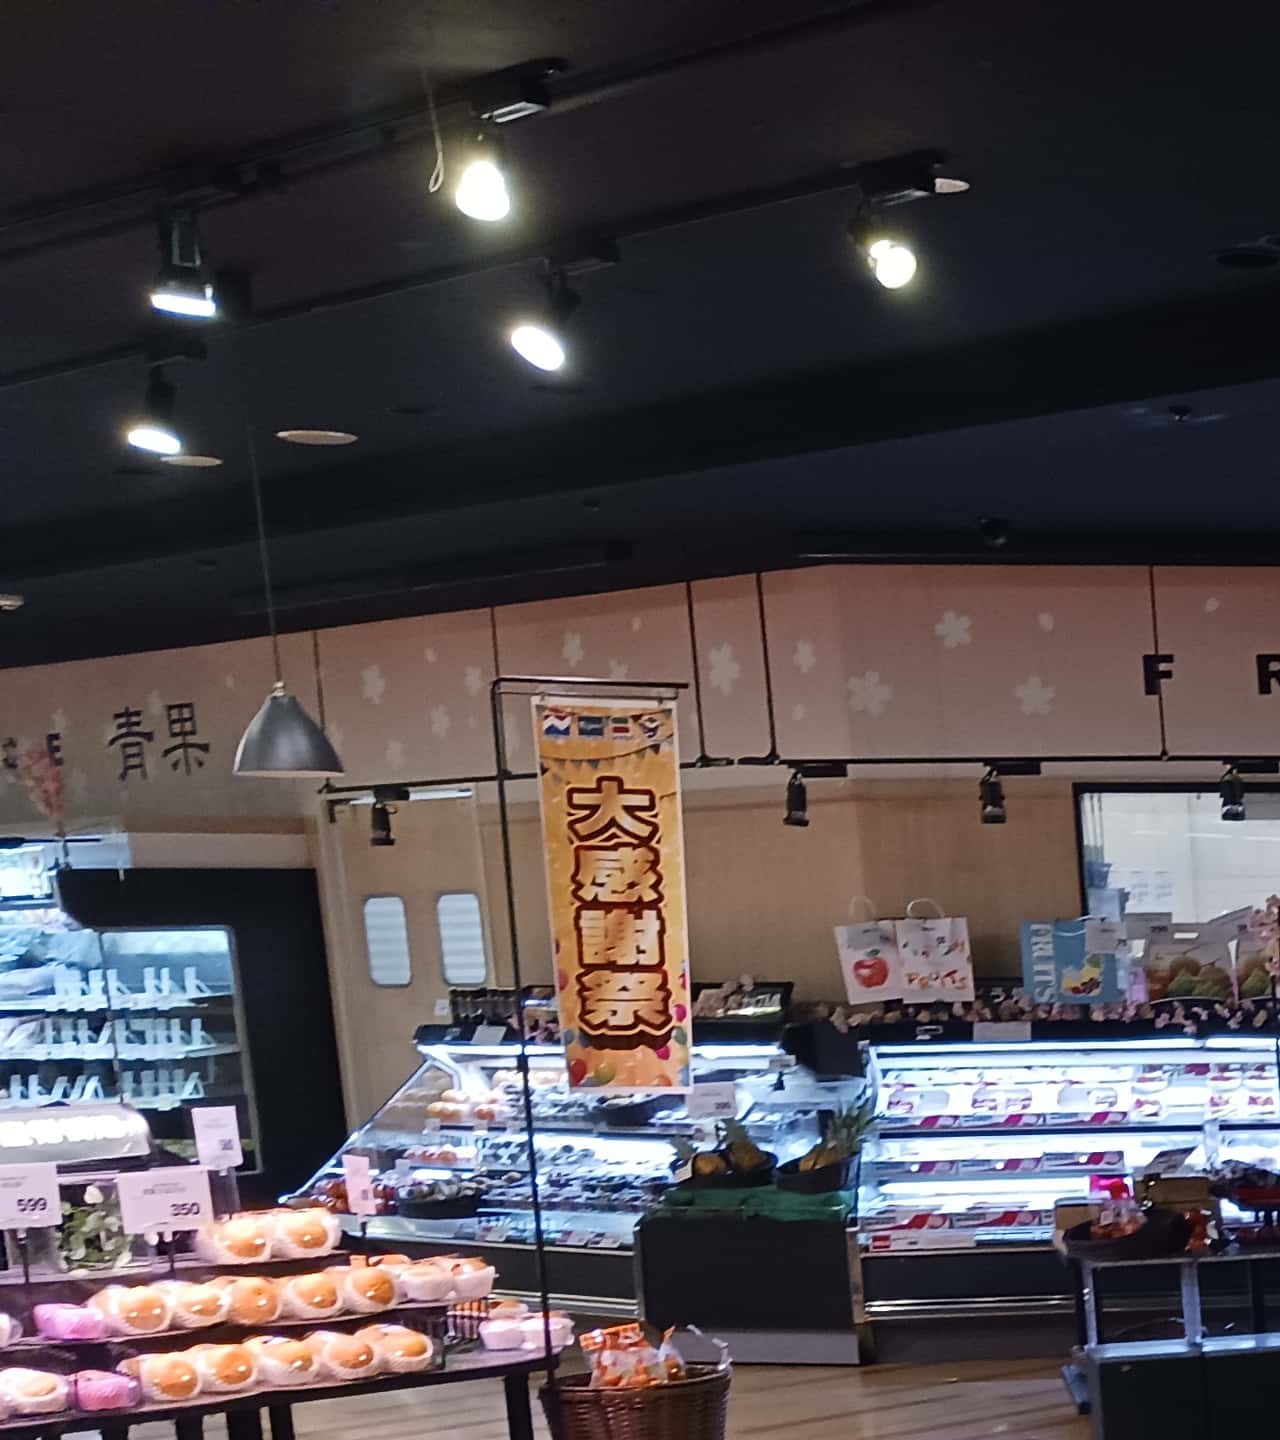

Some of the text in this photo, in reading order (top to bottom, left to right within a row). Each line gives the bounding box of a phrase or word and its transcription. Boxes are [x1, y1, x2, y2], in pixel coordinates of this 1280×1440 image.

[107, 702, 210, 781] 青果
[567, 776, 673, 1033] 大感謝祭
[17, 1197, 48, 1213] 599
[171, 1201, 200, 1217] 350
